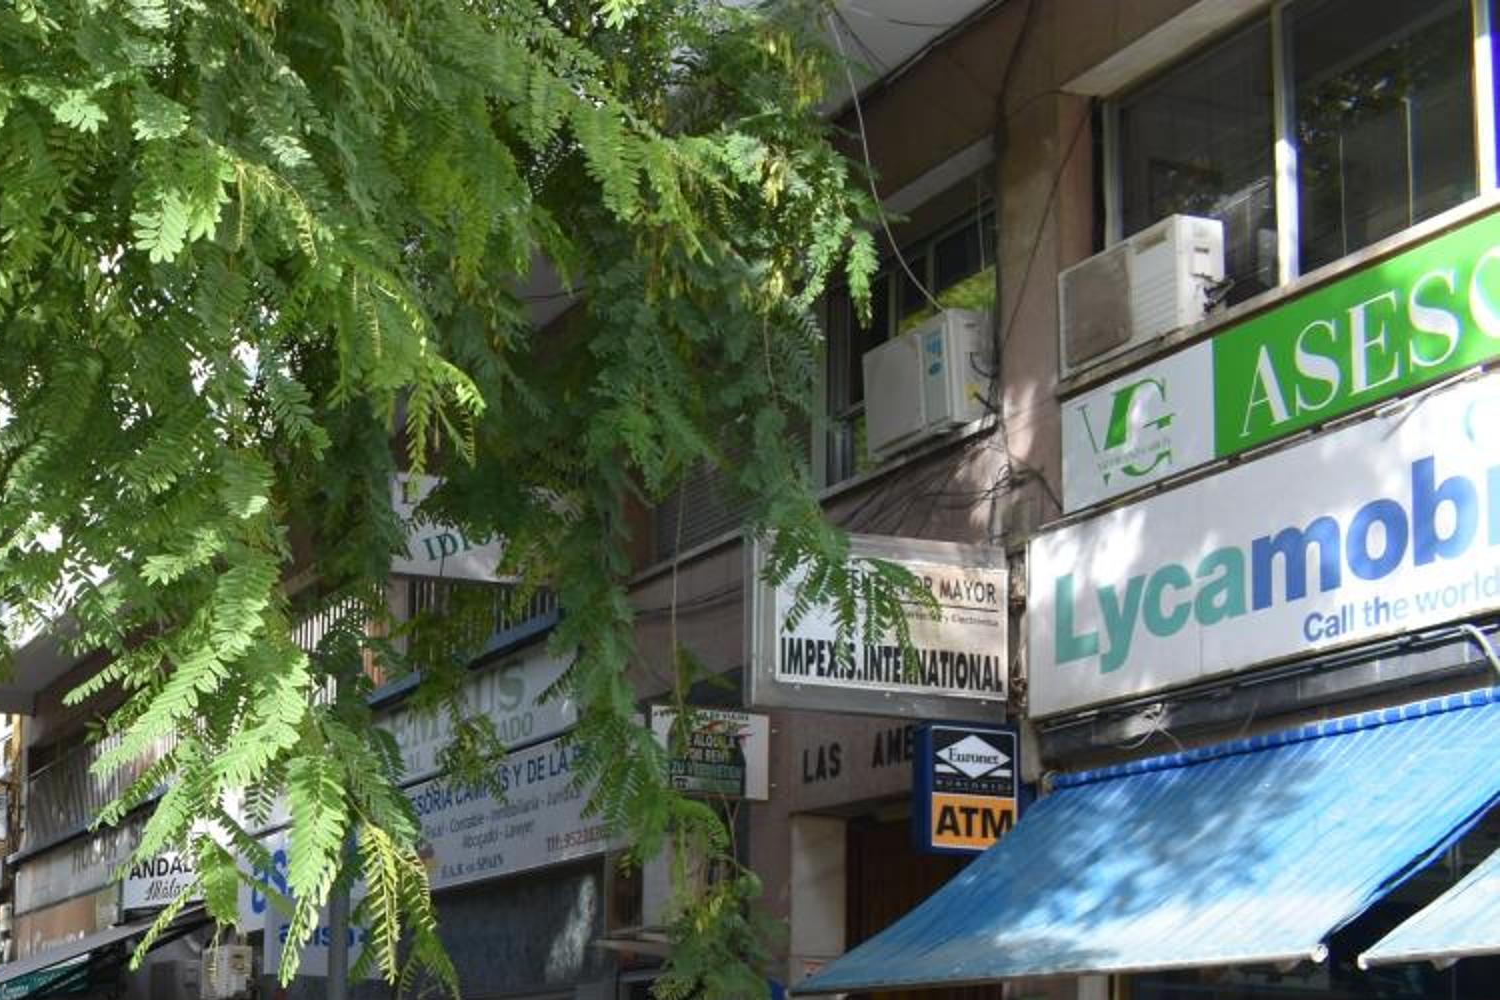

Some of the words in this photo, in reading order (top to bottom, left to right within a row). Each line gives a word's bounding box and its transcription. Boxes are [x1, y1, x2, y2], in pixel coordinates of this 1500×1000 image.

[939, 579, 997, 604] MAYOR
[1303, 609, 1355, 643] Call
[1362, 596, 1409, 629] the
[511, 763, 522, 788] Y
[527, 756, 545, 783] DE
[549, 749, 570, 777] LA
[802, 743, 842, 784] LAS
[948, 747, 1000, 765] Euronet
[935, 805, 1014, 839] ATM
